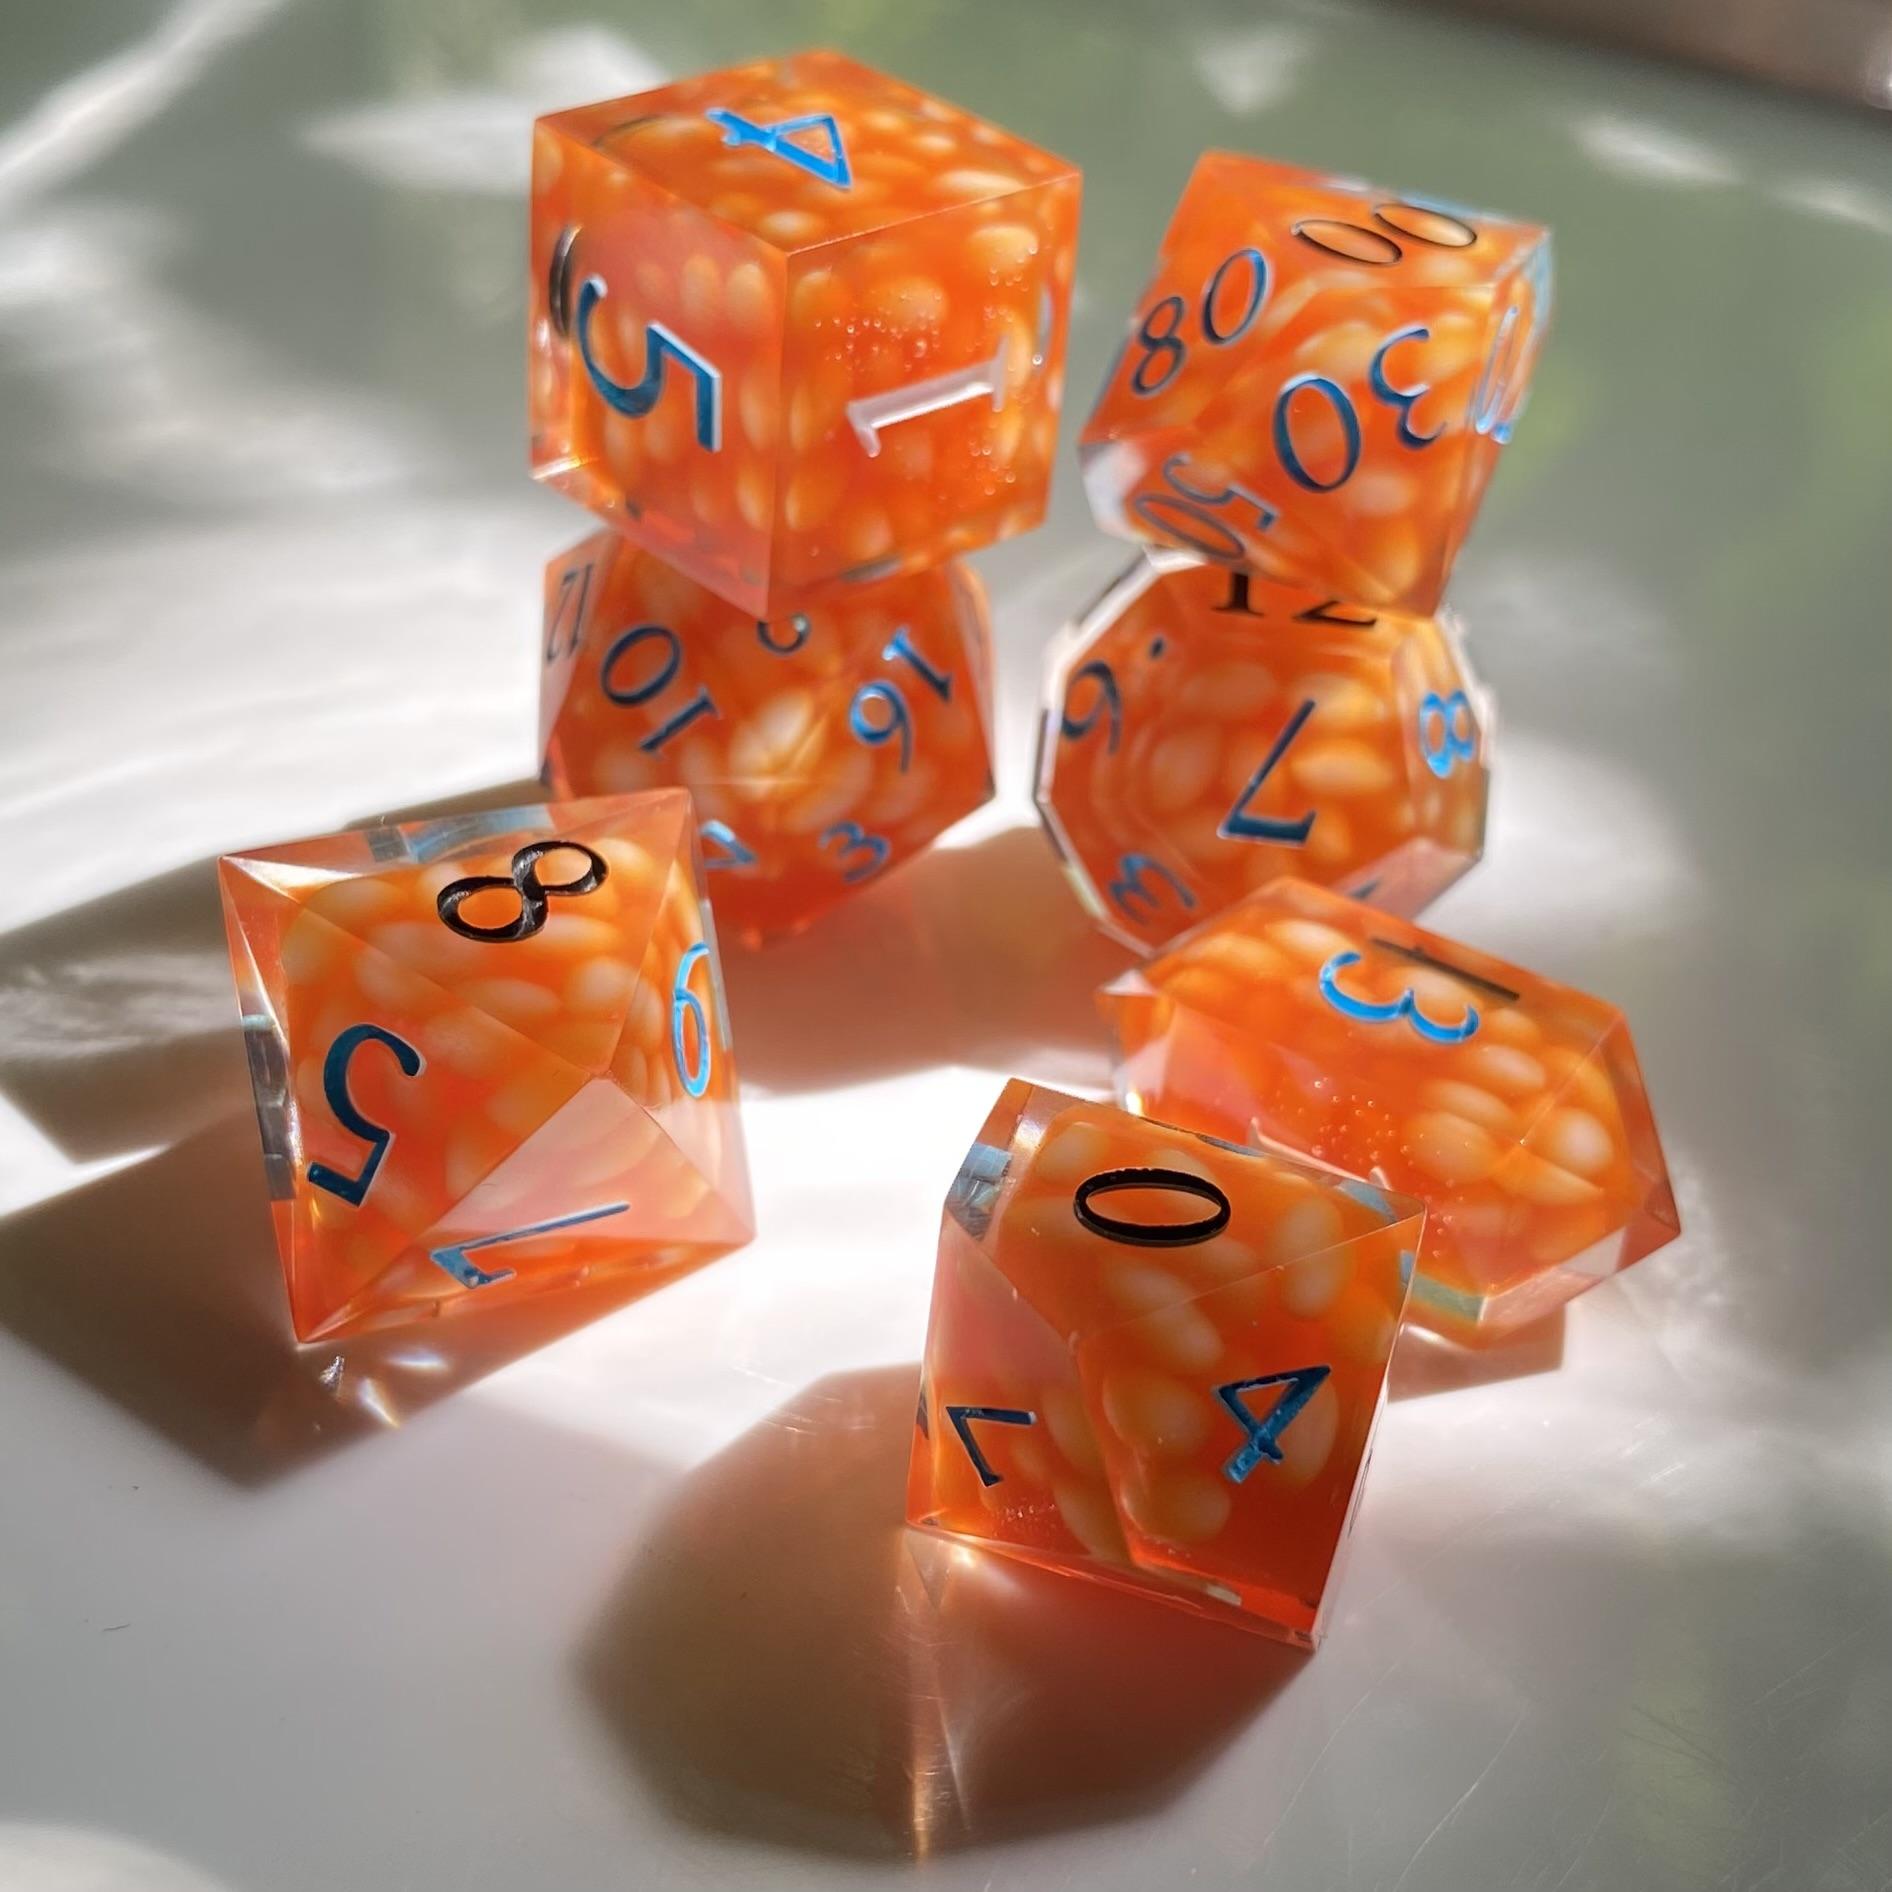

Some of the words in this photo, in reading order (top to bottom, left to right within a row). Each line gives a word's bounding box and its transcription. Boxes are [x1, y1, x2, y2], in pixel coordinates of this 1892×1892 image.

[706, 107, 852, 190] 4
[576, 274, 722, 453] 5
[1131, 247, 1271, 396] 80
[846, 332, 1009, 458] 1
[1217, 700, 1317, 848] 7
[1419, 690, 1477, 779] 8
[437, 840, 609, 943] 8
[1319, 950, 1480, 1044] 3
[306, 1022, 425, 1207] 5
[1073, 1167, 1232, 1248] 0
[1212, 1364, 1332, 1485] 4
